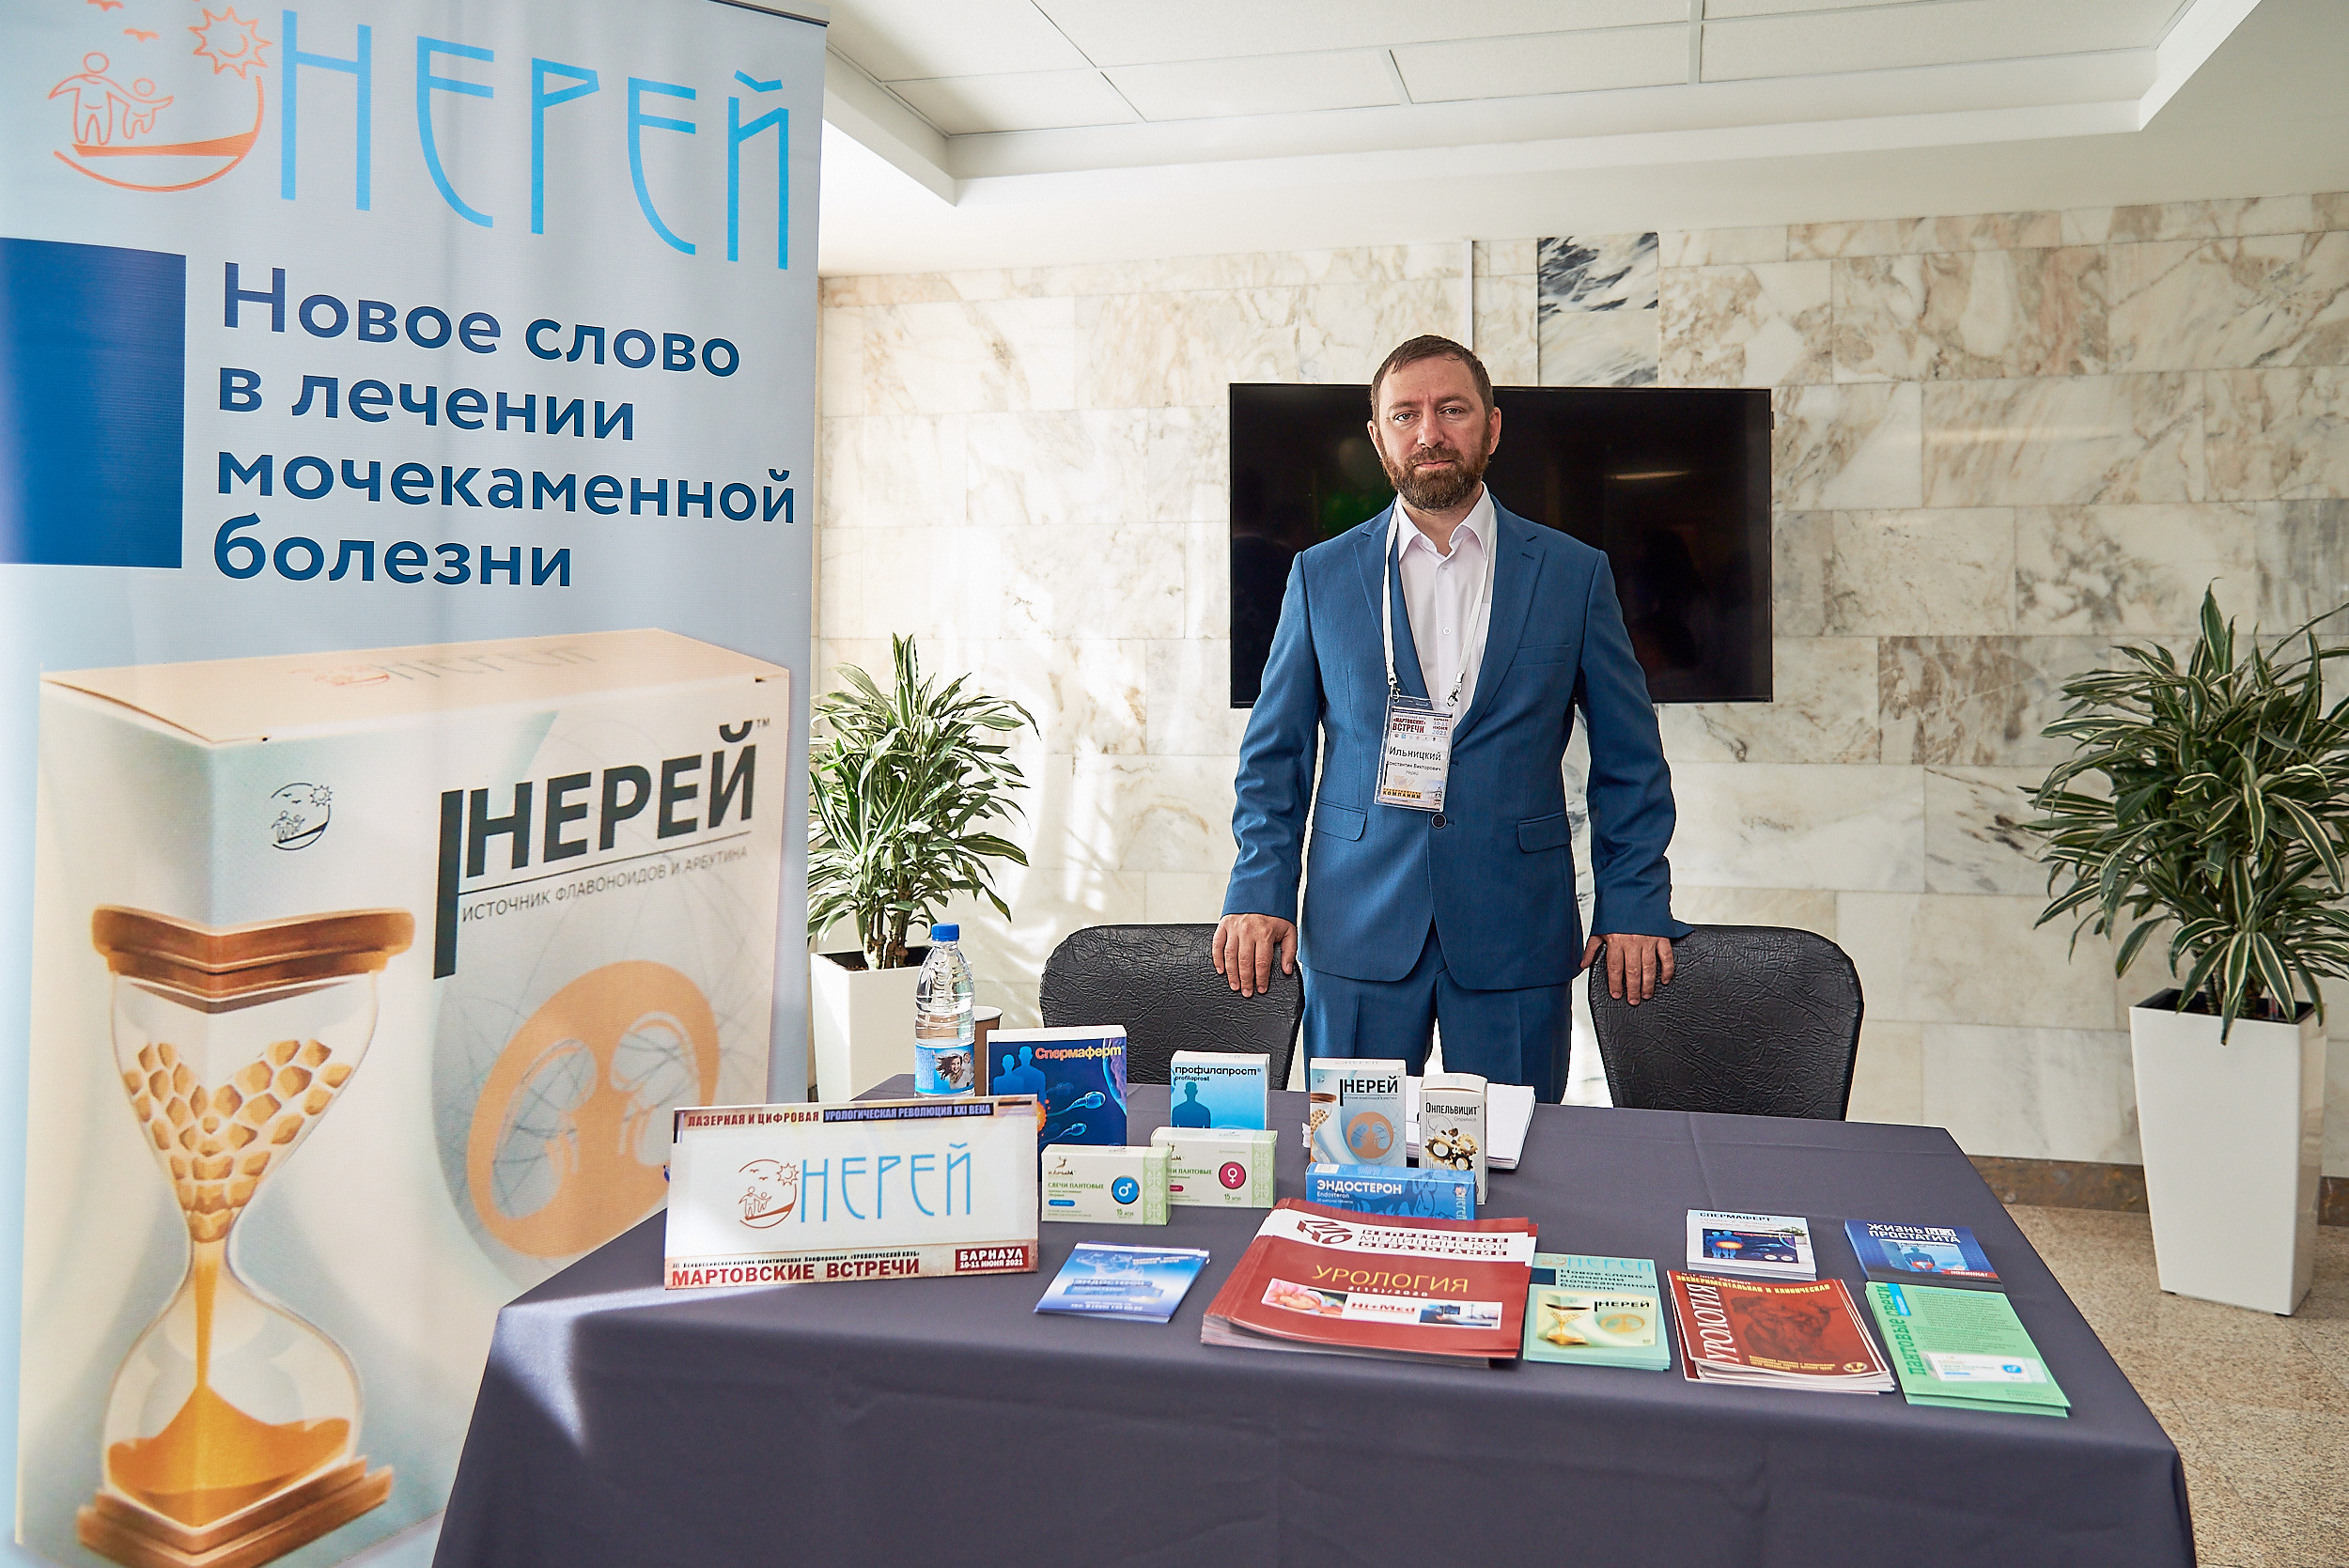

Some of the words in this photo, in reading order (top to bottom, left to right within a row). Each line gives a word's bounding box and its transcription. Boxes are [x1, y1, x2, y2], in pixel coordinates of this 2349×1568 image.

[281, 9, 790, 271] НЕРЕЙ
[223, 261, 502, 355] Новое
[524, 317, 740, 379] слово
[217, 367, 264, 413] в
[291, 374, 634, 442] лечении
[216, 450, 796, 524] мочекаменной
[212, 512, 571, 587] болезни
[1392, 723, 1424, 734] ВСТРЕЧИ
[1389, 746, 1441, 761] Ильницкий
[461, 889, 552, 923] ИСТОЧНИК
[554, 863, 667, 903] ФЛАВОНОИДОВ
[670, 861, 680, 877] И
[683, 845, 748, 875] АРБУТИНА
[1034, 1045, 1122, 1061] Спермаферт
[1344, 1075, 1399, 1094] НЕРЕЙ
[688, 1114, 745, 1127] ЛАЗЕРНАЯ
[748, 1113, 756, 1125] И
[757, 1111, 819, 1126] ЦИФРОВАЯ
[824, 1108, 896, 1122] УРОЛОГИЧЕСКАЯ
[898, 1105, 953, 1119] РЕВОЛЮЦИЯ
[953, 1105, 968, 1116] XXI
[969, 1104, 991, 1115] ВЕКА
[1425, 1102, 1478, 1116] Онпельвицит
[1177, 1167, 1212, 1175] ПАНТОВЫЕ
[801, 1141, 972, 1223] НЕРЕЙ
[1316, 1179, 1402, 1195] ЭНДОСТЕРОН
[1316, 1190, 1350, 1199] Endosteron
[1699, 1212, 1771, 1222] СПЕРМАФЕРТ
[1866, 1223, 1924, 1234] ЖИЗНЬ
[1360, 1234, 1508, 1250] МЕДИЦИНСКОЕ
[1868, 1230, 1962, 1244] ПРОСТАТИТА
[959, 1248, 1023, 1262] БАРНАУЛ
[1358, 1242, 1508, 1256] ОБРАЗОВАНИЕ
[672, 1263, 815, 1286] МАРТОВСКИЕ
[826, 1258, 920, 1279] ВСТРЕЧИ
[1312, 1265, 1469, 1293] УРОЛОГИЯ
[1560, 1282, 1614, 1291] болезни
[1675, 1275, 1764, 1293] ЭКСПЕРИМЕНТАЛЬНАЯ
[1774, 1283, 1830, 1295] КЛИНИЧЕСКАЯ
[1598, 1299, 1651, 1308] НЕРЕЙ
[1686, 1282, 1740, 1363] УРОЛОГИЯ
